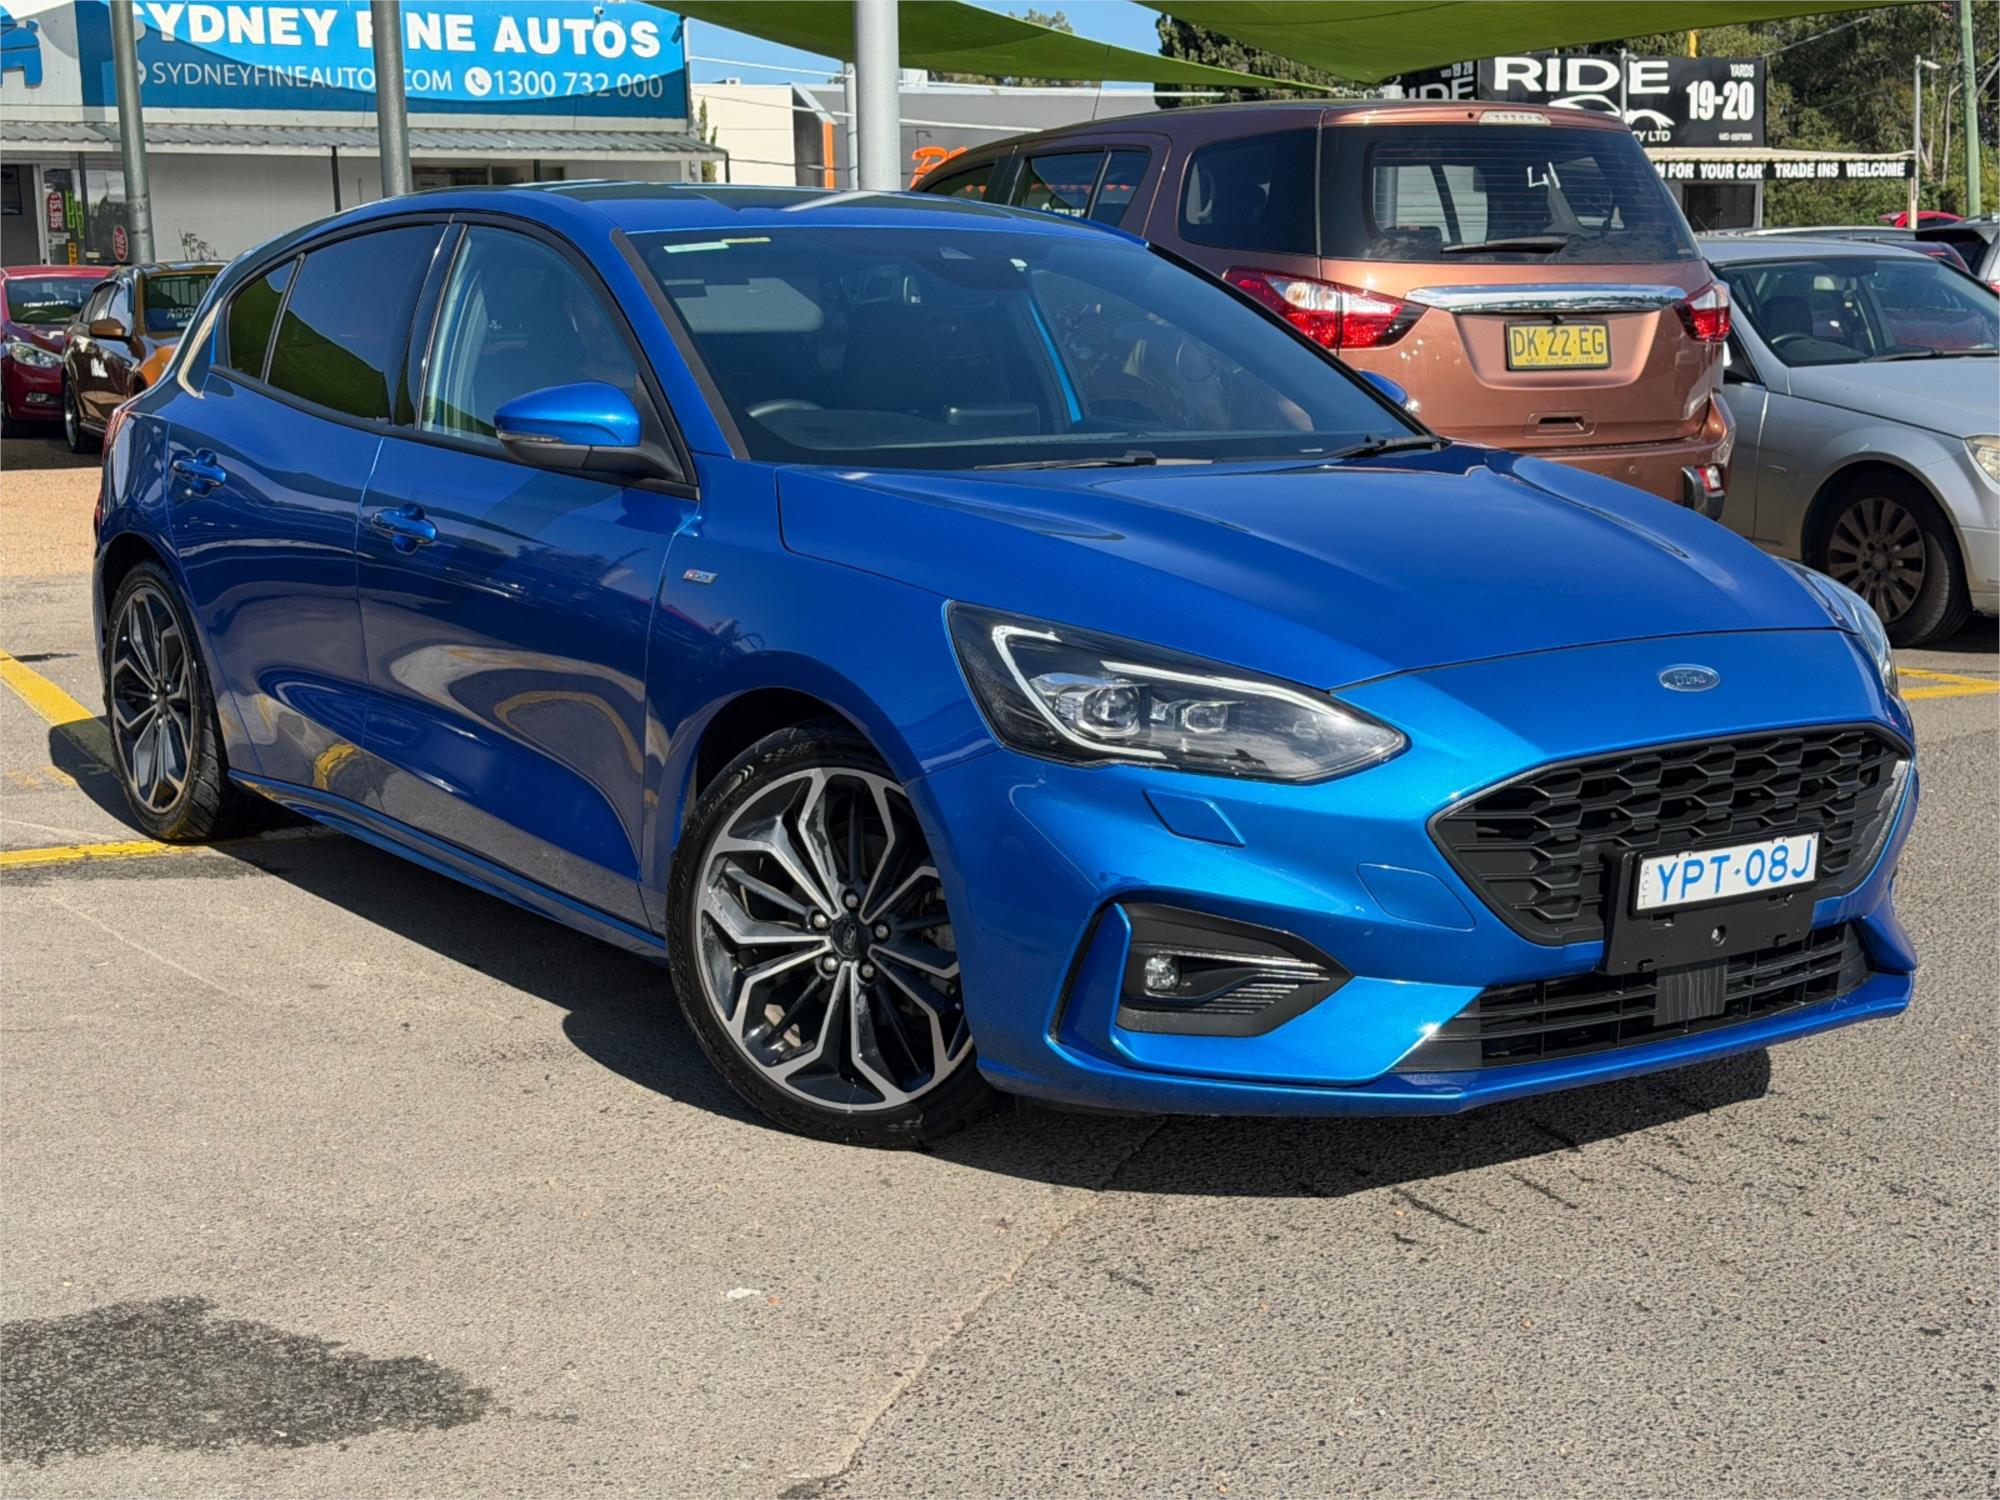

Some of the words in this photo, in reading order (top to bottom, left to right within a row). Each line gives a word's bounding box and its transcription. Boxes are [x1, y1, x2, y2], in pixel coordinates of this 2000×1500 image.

[357, 11, 476, 51] FNE
[493, 16, 661, 58] AUTOS
[1494, 56, 1671, 94] RIDE
[1730, 64, 1754, 77] YARDS
[493, 70, 556, 95] 1300
[563, 72, 610, 96] 732
[617, 73, 663, 98] 000
[1403, 76, 1474, 101] IDE
[1686, 80, 1755, 120] 19-20
[1648, 130, 1671, 142] LTD
[1668, 163, 1695, 178] FOR
[1700, 163, 1734, 179] YOUR
[1774, 163, 1815, 178] TRADE
[1817, 163, 1838, 178] INS
[1846, 162, 1905, 178] WELCOME
